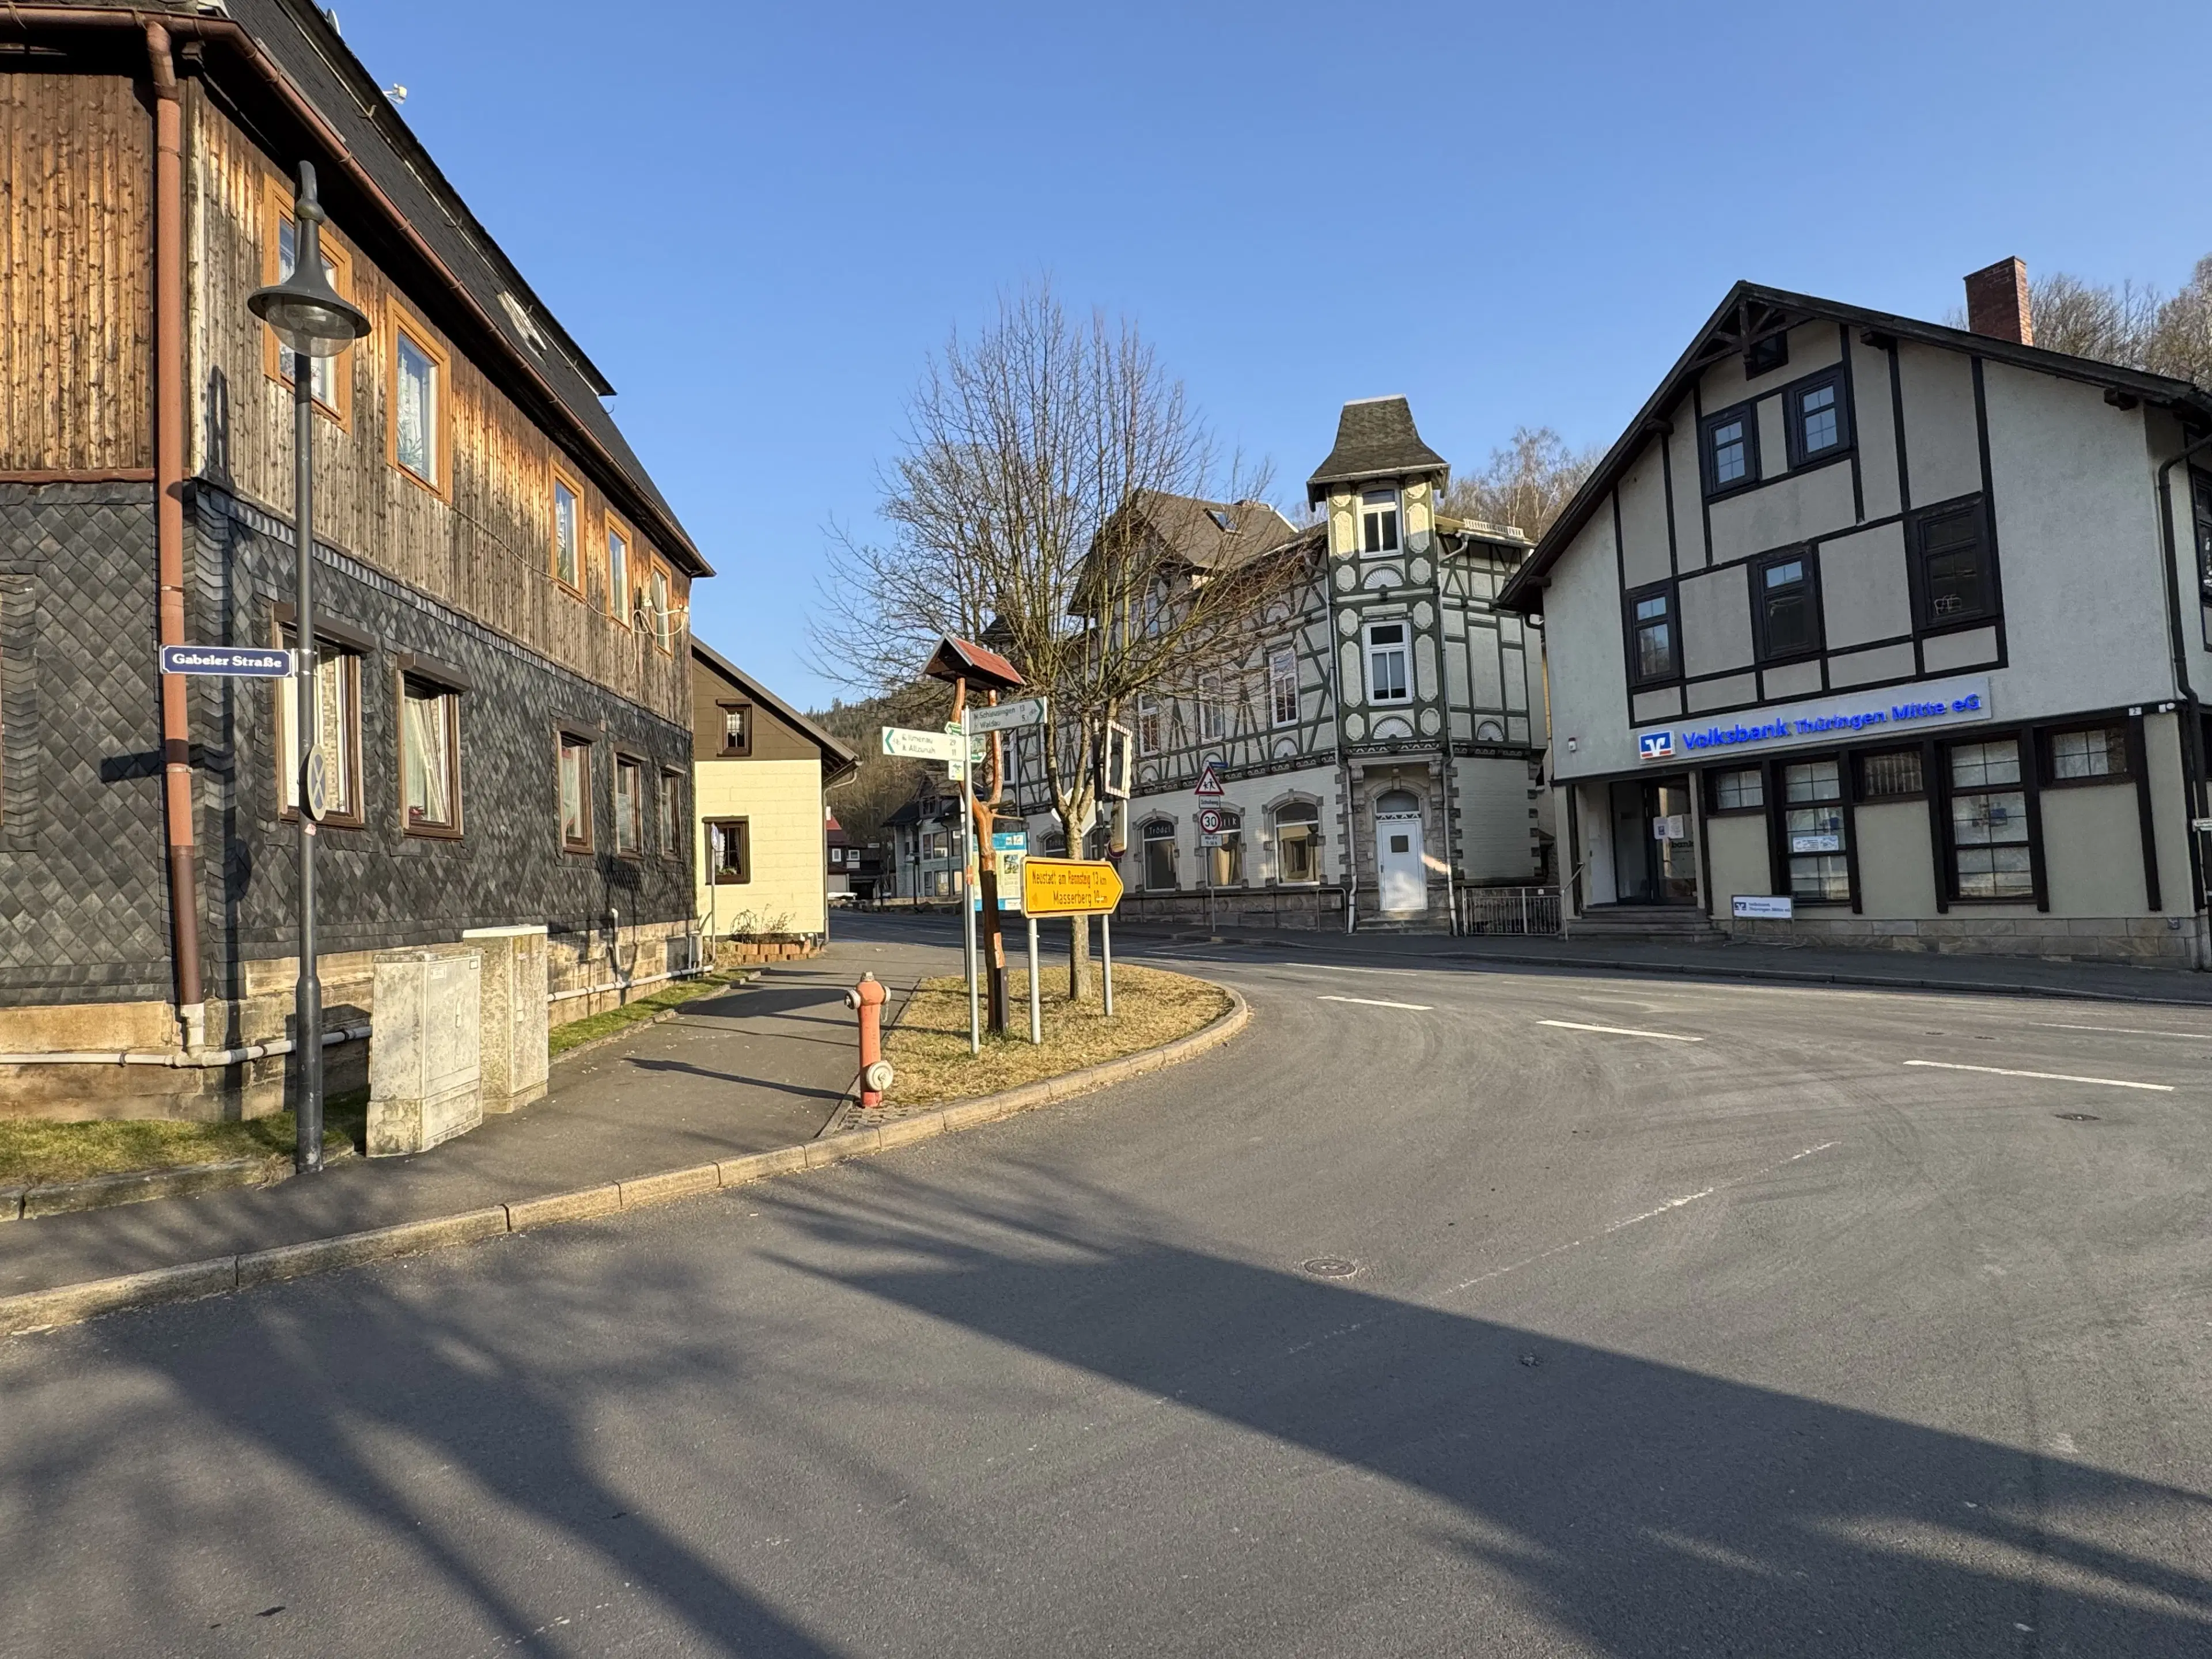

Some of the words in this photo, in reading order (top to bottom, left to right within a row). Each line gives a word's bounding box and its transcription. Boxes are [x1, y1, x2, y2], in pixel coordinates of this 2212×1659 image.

[172, 653, 229, 666] Gabeler
[232, 656, 282, 668] Straße
[1682, 717, 1791, 750] Volksbank
[1794, 710, 1887, 734] Thüringen
[1891, 700, 1946, 720] Mitte
[1951, 694, 1982, 713] eG
[1149, 824, 1171, 835] Trödel
[1204, 816, 1217, 827] 30
[1032, 869, 1056, 885] Neustadt
[1058, 874, 1066, 885] am
[1068, 870, 1091, 889] Rennsteig
[1093, 871, 1099, 885] 13
[1100, 875, 1107, 885] km
[1053, 889, 1092, 907] Masserberg
